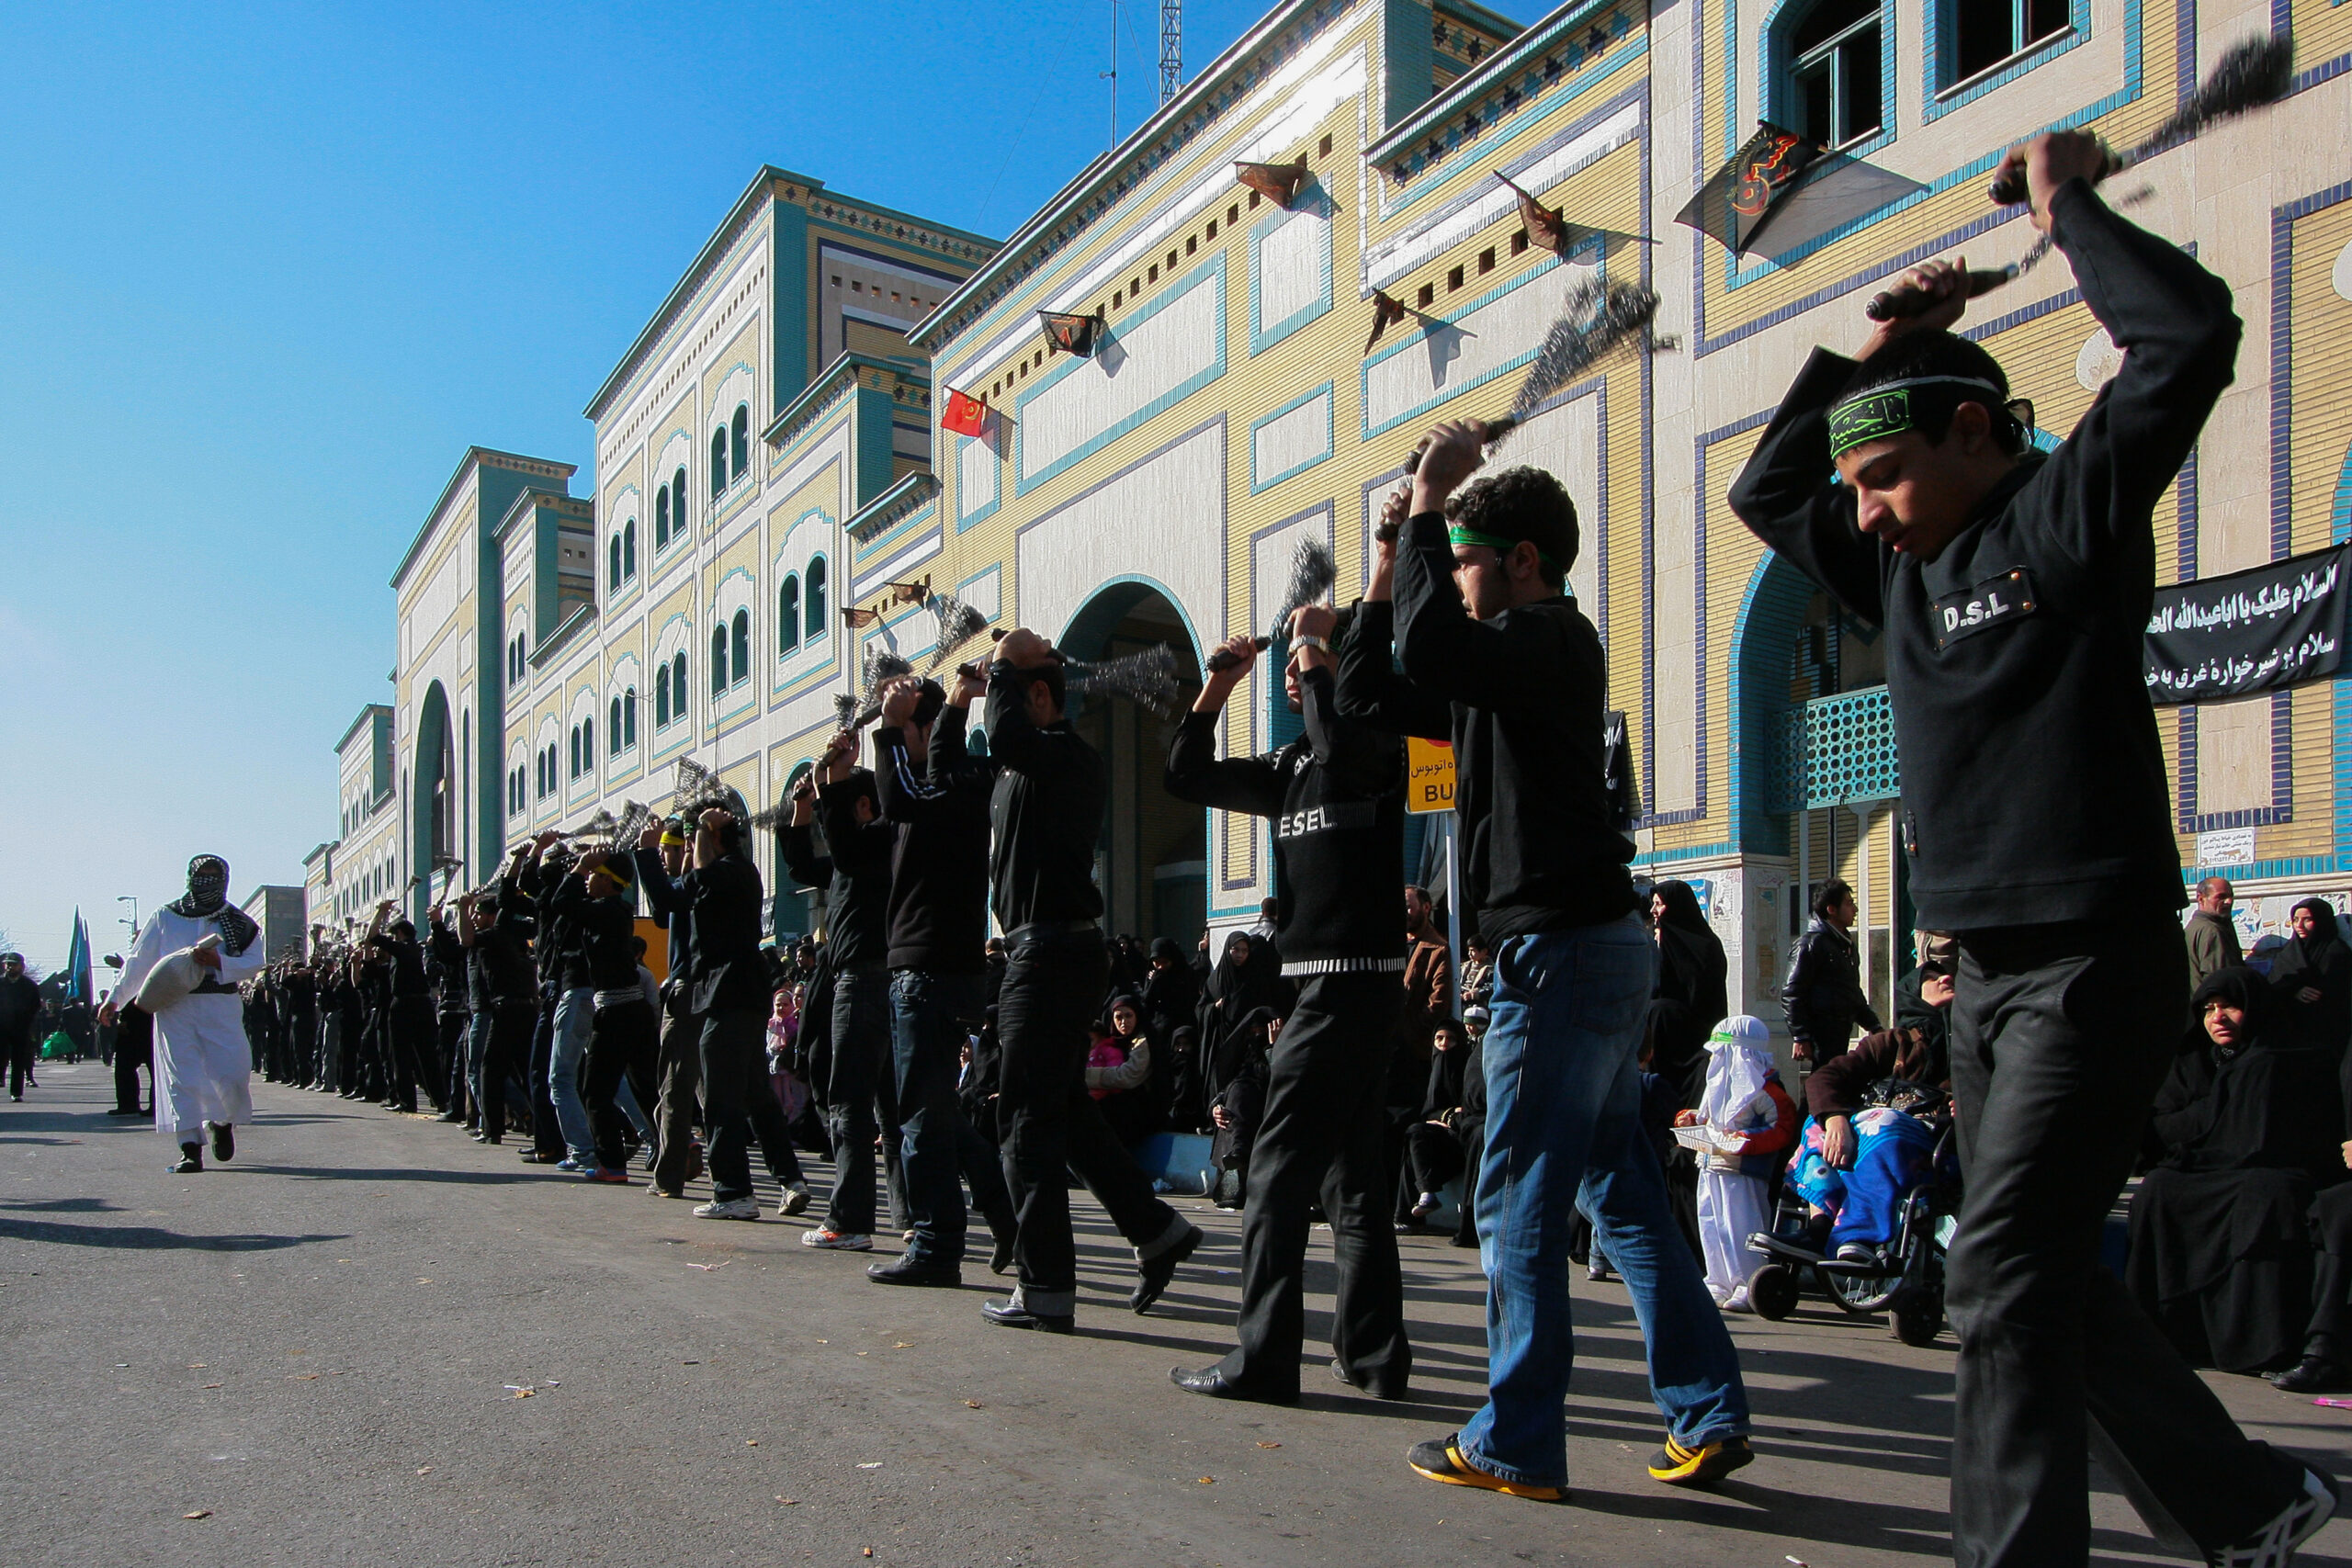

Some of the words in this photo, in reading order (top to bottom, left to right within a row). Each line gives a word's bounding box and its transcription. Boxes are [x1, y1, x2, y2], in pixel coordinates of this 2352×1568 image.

[2251, 582, 2290, 618] علیک
[2292, 563, 2338, 614] السلام
[1943, 592, 2009, 632] D.S.L
[2145, 605, 2172, 633] الح
[2238, 592, 2251, 625] یا
[2282, 646, 2295, 669] بر
[2299, 632, 2335, 665] سلام
[2174, 662, 2208, 689] غرق
[1411, 759, 1447, 778] اتوبوس
[1424, 783, 1453, 802] BU
[1278, 805, 1336, 838] ESEL
